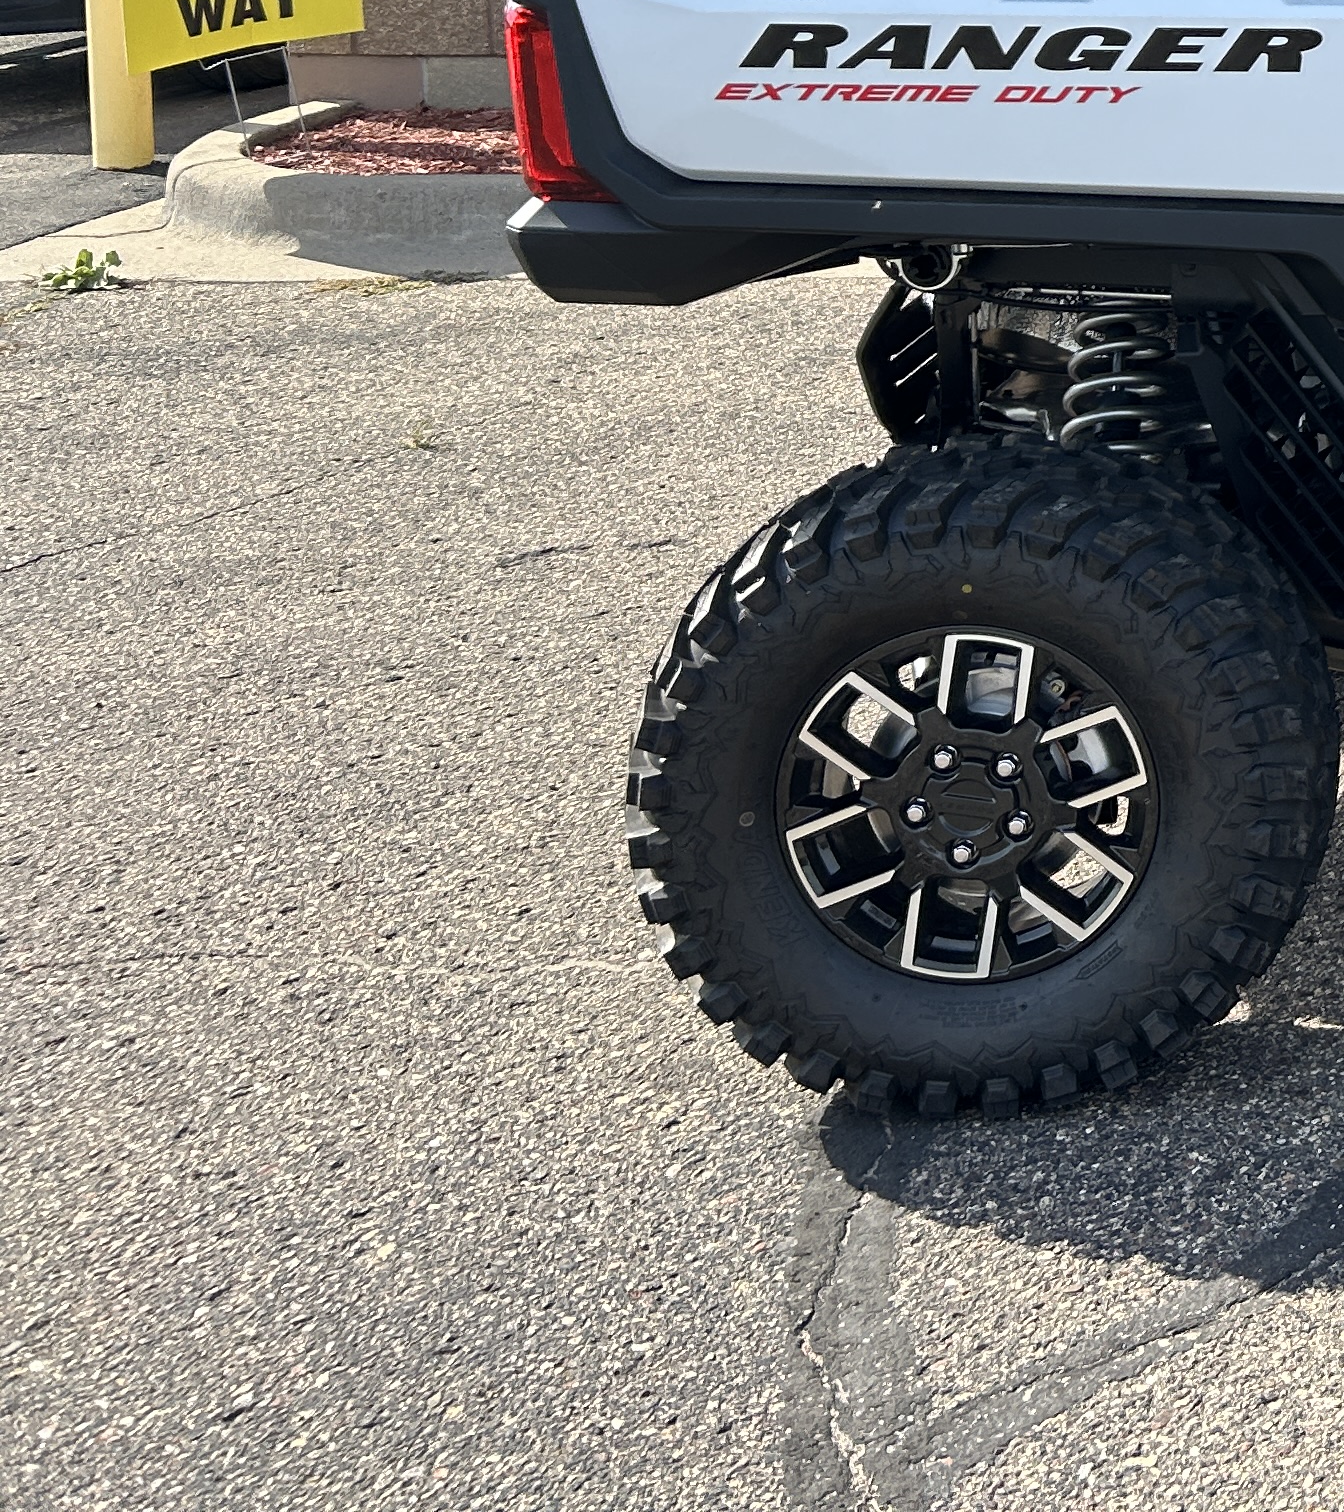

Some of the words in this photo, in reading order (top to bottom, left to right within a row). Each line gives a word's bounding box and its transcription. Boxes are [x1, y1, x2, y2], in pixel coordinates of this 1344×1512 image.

[738, 22, 1323, 73] RANGER
[714, 82, 980, 102] EXTREME
[994, 85, 1143, 104] DUTY
